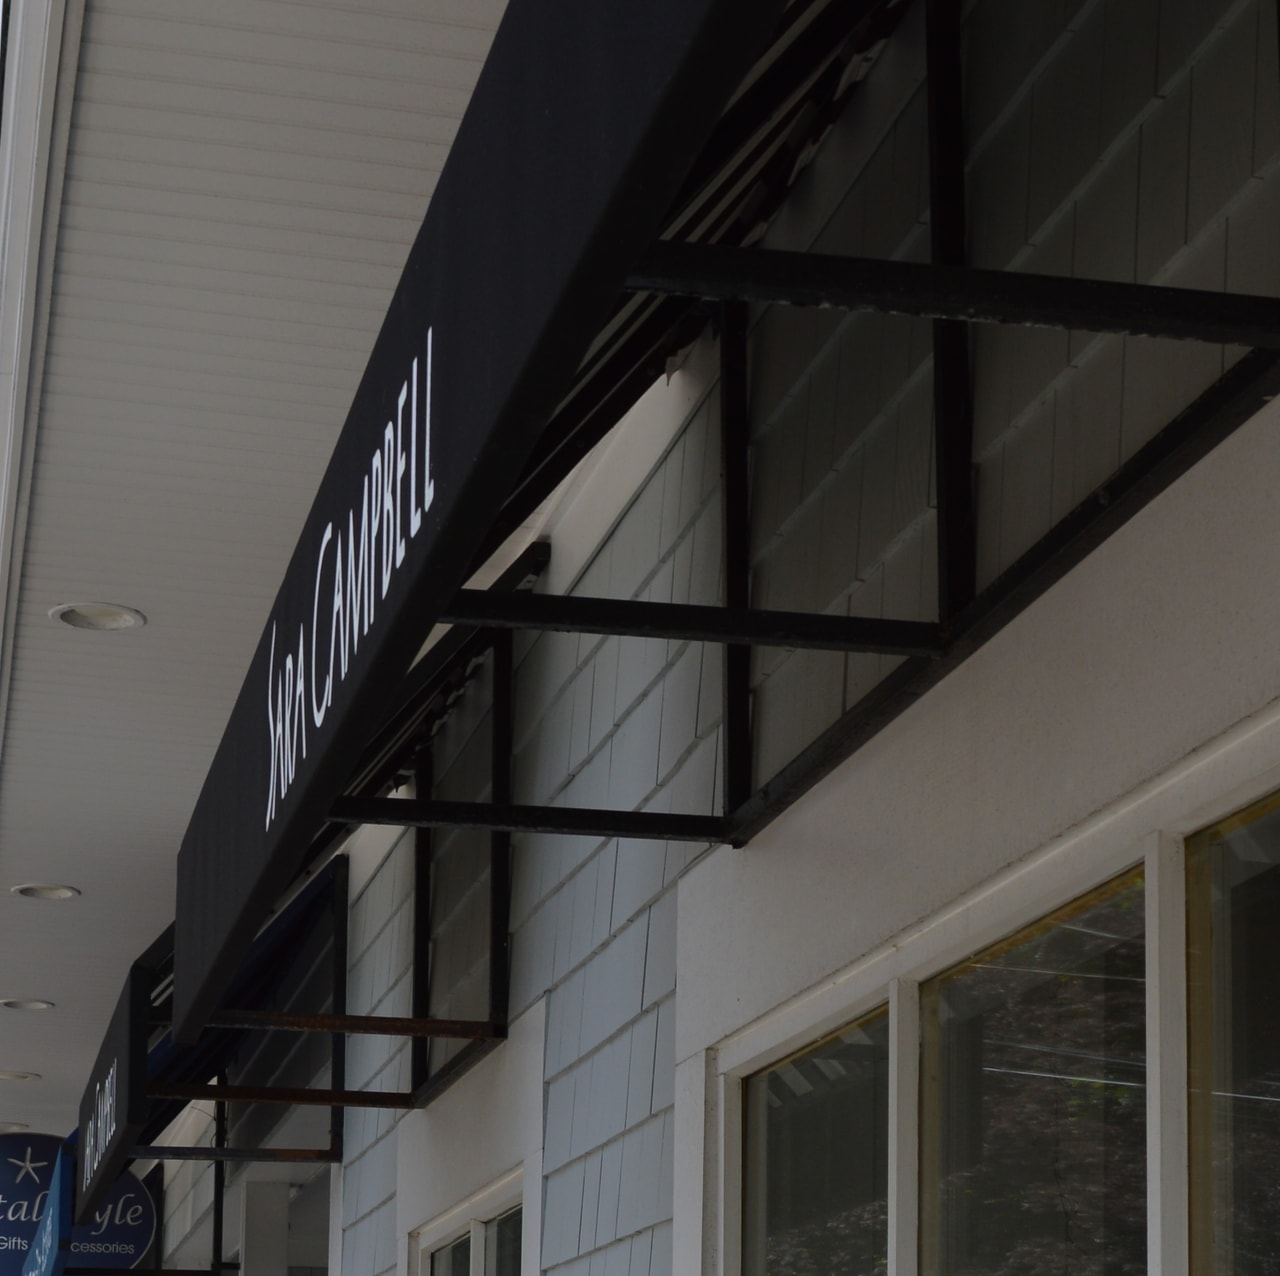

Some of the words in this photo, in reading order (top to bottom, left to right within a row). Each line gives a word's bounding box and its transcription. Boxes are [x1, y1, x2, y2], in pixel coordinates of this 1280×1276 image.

[265, 619, 307, 833] SARA
[311, 325, 435, 729] CAMPBELL
[91, 1193, 143, 1235] yle
[70, 1240, 134, 1255] cessories
